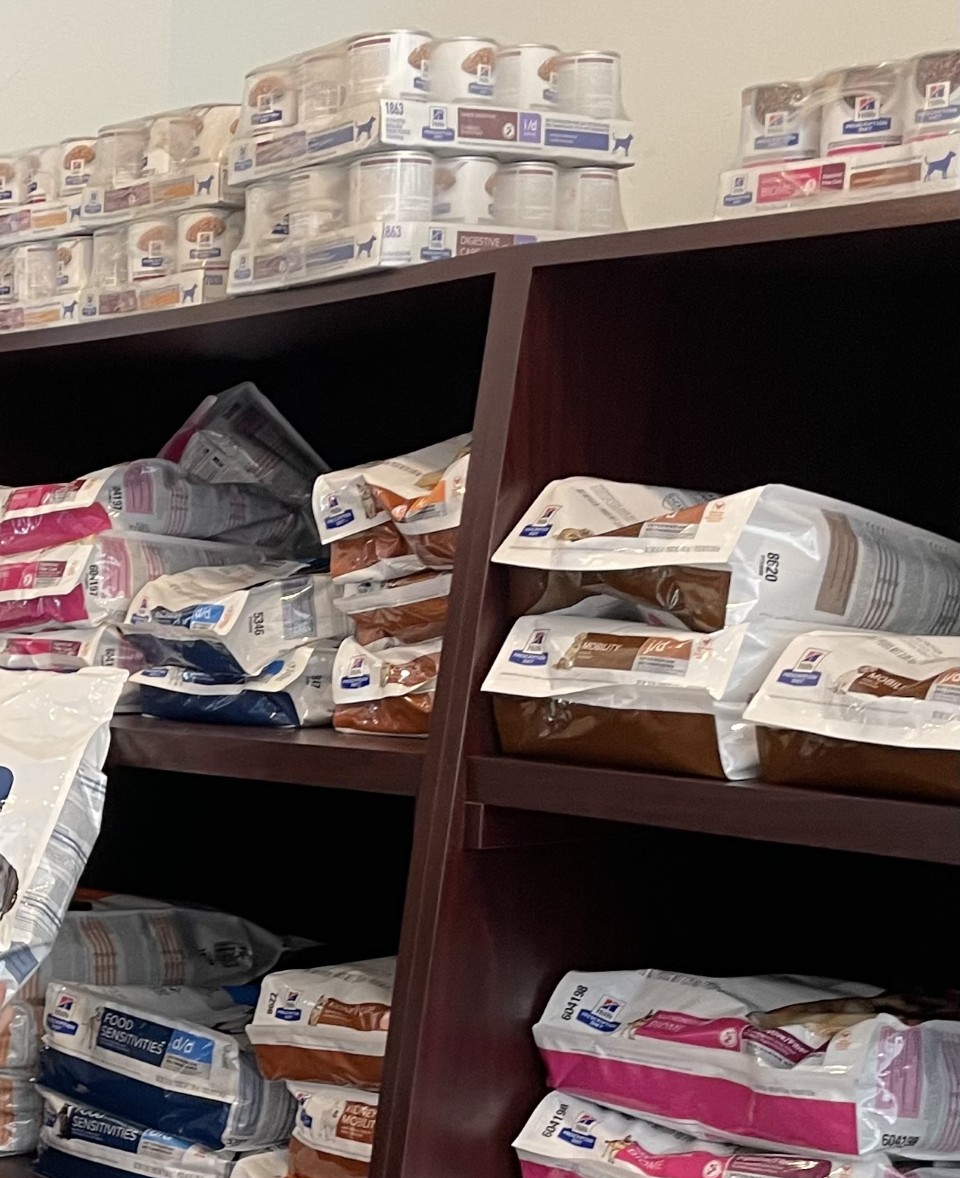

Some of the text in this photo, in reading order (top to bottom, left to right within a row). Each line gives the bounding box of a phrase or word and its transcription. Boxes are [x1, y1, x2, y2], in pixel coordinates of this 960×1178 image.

[385, 102, 404, 116] 1863
[460, 236, 501, 248] DIGESTIVE
[765, 552, 780, 582] 8620
[253, 612, 265, 636] 5346
[582, 641, 624, 652] MOBILITY
[561, 984, 588, 1021] 604198
[104, 1013, 134, 1031] FOOD
[100, 1025, 165, 1056] SENSITIVITIES
[171, 1036, 195, 1054] d/d
[71, 1116, 140, 1143] SENSITIVITIES
[342, 1114, 376, 1129] MOBILIT
[541, 1103, 569, 1137] 604198
